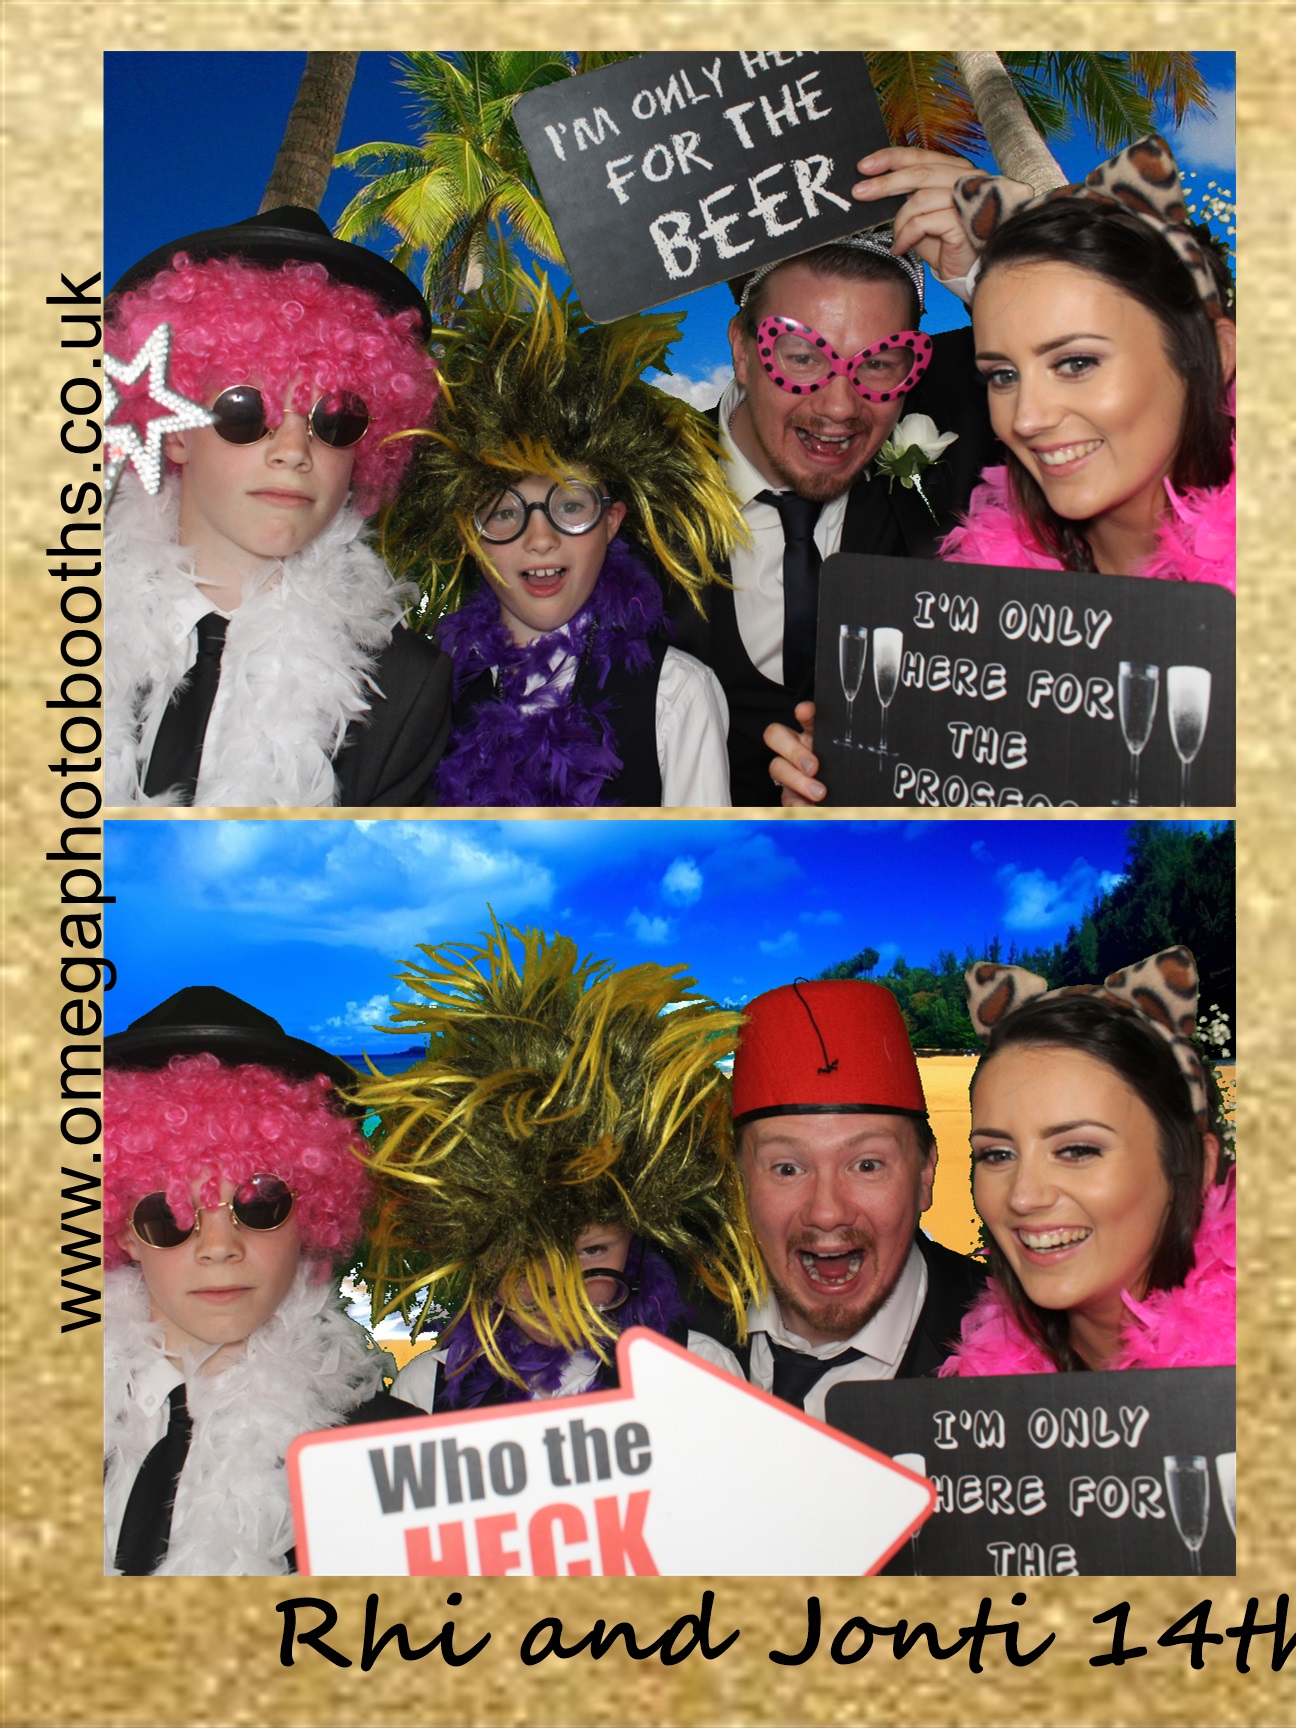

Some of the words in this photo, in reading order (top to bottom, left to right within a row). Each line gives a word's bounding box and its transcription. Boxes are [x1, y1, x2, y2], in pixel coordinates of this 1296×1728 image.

[544, 106, 620, 161] I'M
[630, 56, 724, 121] ONLY
[604, 130, 714, 205] FOR
[722, 70, 833, 149] THE
[648, 154, 852, 280] BEER
[912, 591, 979, 634] I'M
[999, 600, 1113, 650] ONLY
[900, 651, 1008, 701] HERE
[1027, 670, 1115, 720] FOR
[947, 721, 1028, 770] THE
[933, 1410, 1006, 1450] I'M
[1028, 1405, 1150, 1449] ONLY
[368, 1437, 529, 1515] Who
[542, 1418, 653, 1488] the
[928, 1475, 1048, 1517] HERE
[1069, 1475, 1167, 1520] FOR
[403, 1489, 662, 1577] HECK
[986, 1541, 1080, 1576] THE
